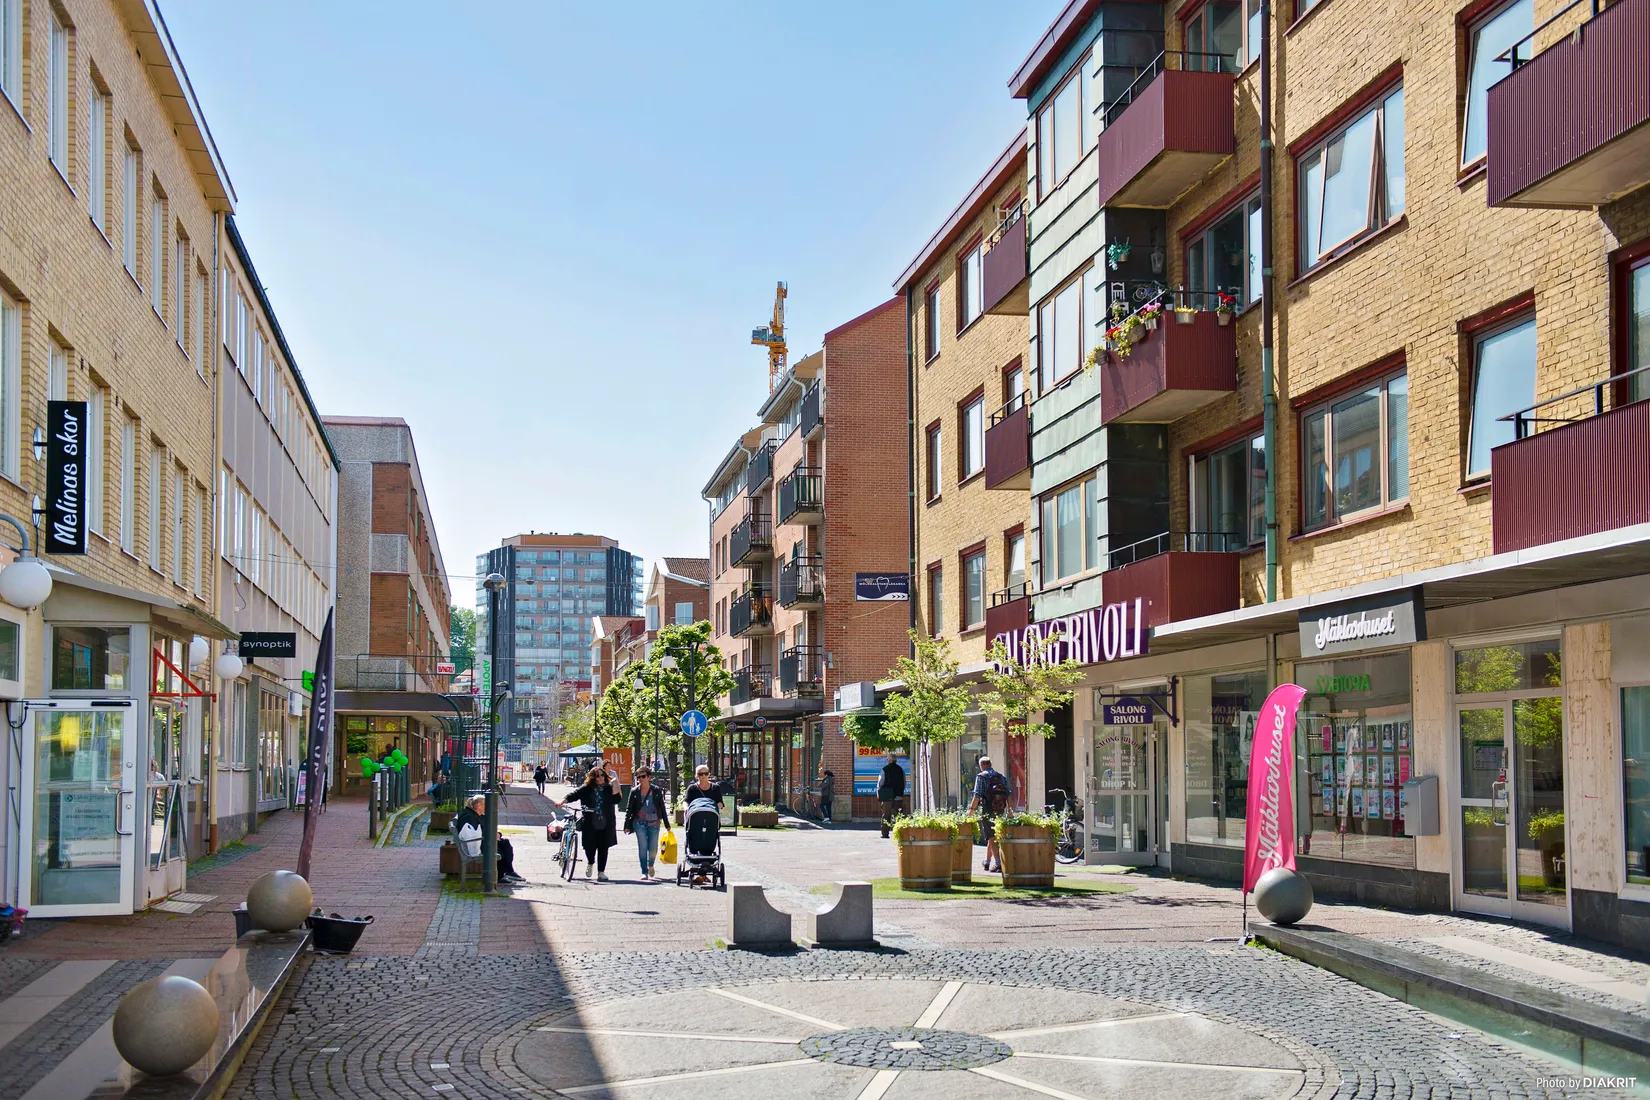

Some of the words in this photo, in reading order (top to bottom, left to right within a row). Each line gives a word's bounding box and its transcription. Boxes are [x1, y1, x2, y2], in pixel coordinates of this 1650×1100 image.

[55, 408, 79, 456] skor
[53, 462, 79, 546] Melinas
[1067, 596, 1142, 665] RIVOLI
[1314, 609, 1396, 649] Mäklarhuset
[243, 640, 292, 649] synoptik
[1110, 705, 1147, 714] SALONG
[1113, 715, 1144, 724] RIVOLI
[1095, 736, 1120, 750] SALONG
[858, 747, 870, 756] 99
[1100, 780, 1126, 788] DROP
[1128, 780, 1137, 788] IN
[1257, 703, 1287, 869] Mäklarhuset
